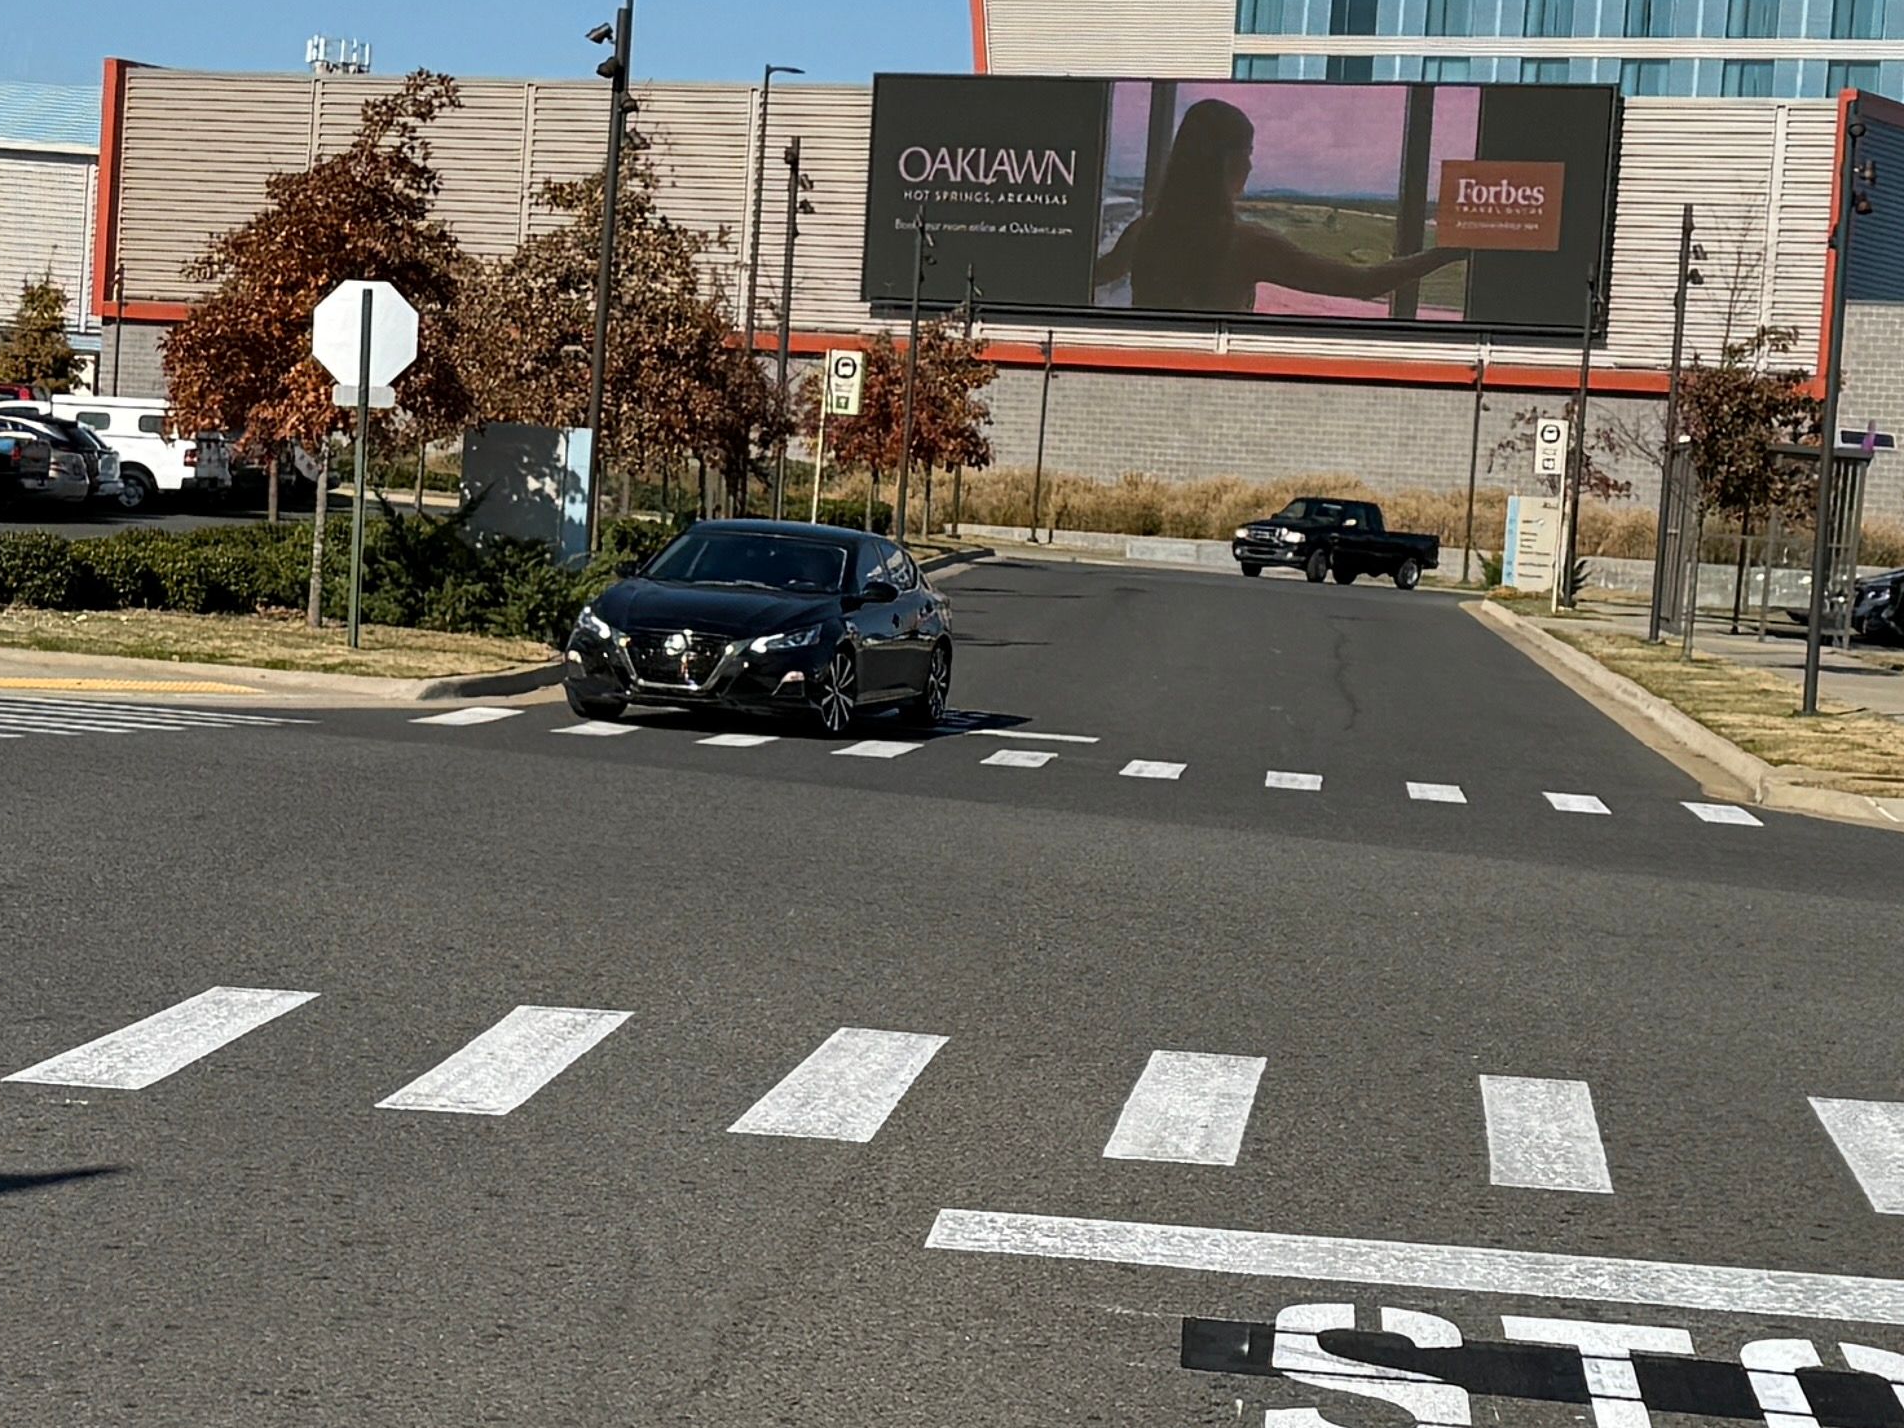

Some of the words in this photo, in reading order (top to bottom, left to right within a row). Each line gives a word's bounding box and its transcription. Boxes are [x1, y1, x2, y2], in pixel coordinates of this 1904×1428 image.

[899, 147, 1076, 186] OAKLAWN
[904, 190, 929, 201] HOT
[935, 190, 994, 204] SPRINGS,
[998, 192, 1067, 205] ARKANSAS
[1457, 179, 1544, 205] Forbes
